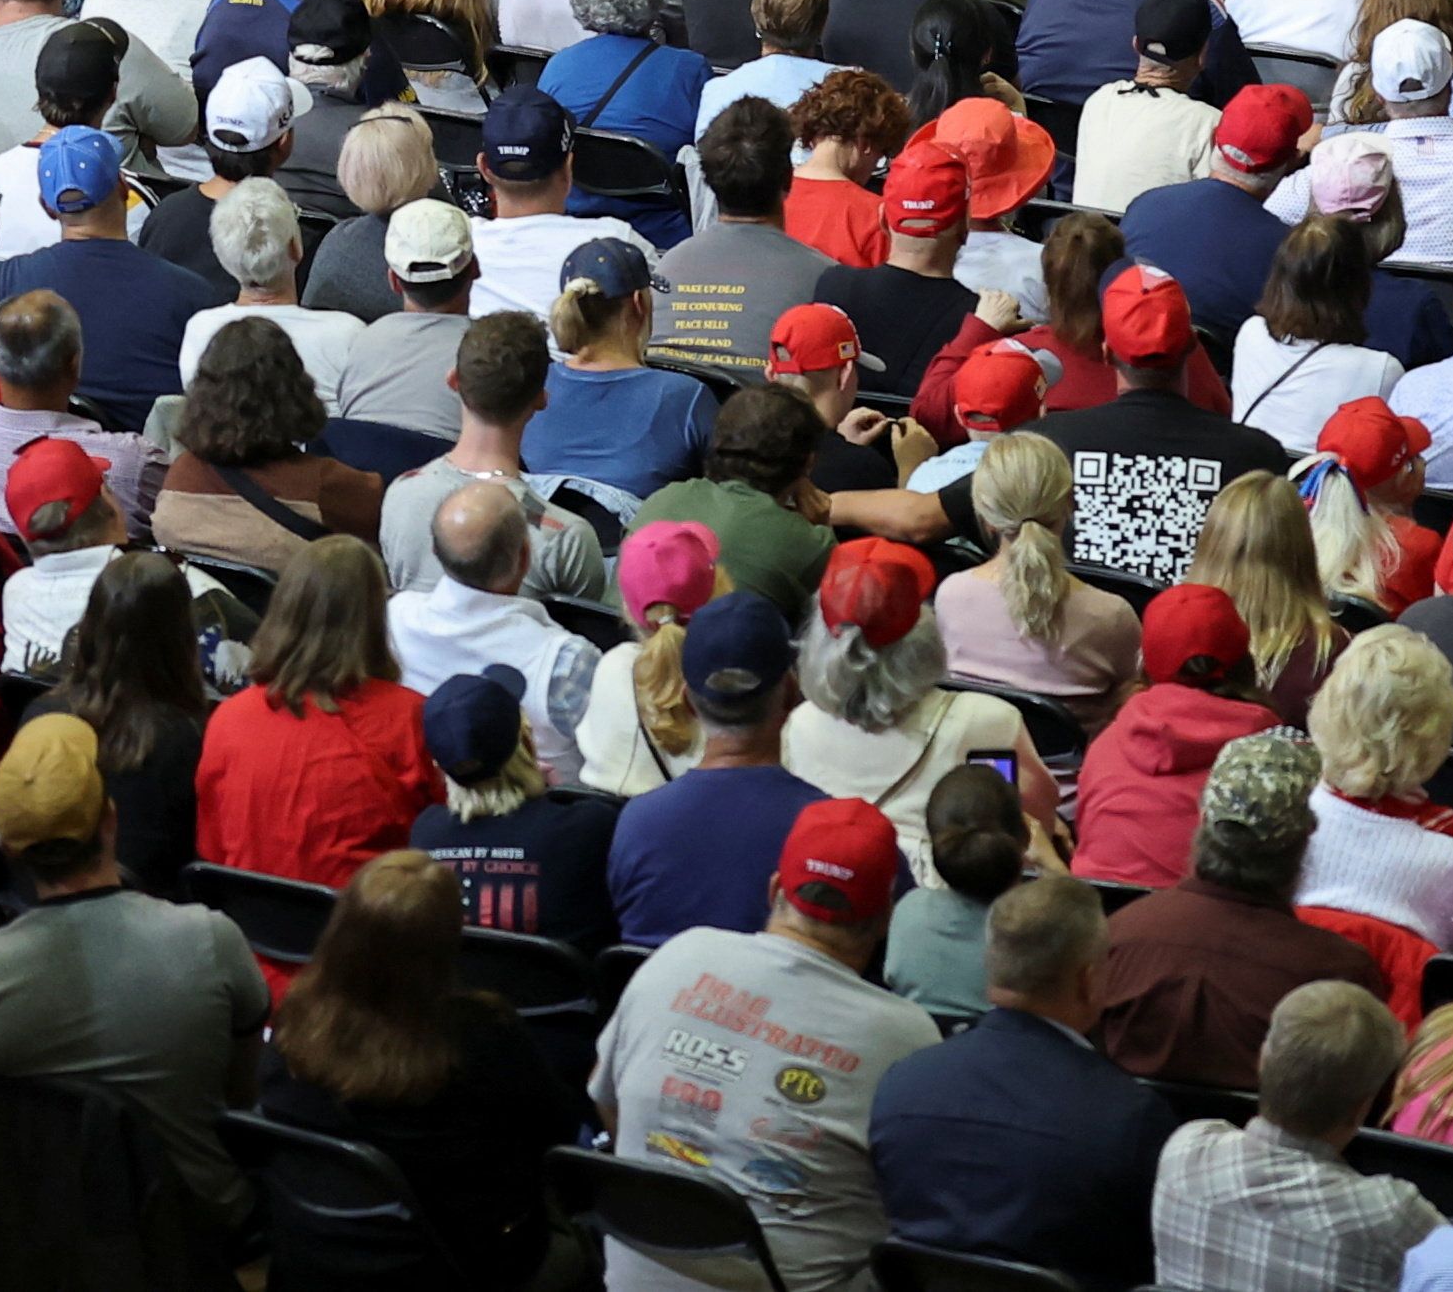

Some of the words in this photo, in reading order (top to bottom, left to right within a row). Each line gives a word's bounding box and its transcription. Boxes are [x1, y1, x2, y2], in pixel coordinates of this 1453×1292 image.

[497, 145, 530, 156] TRUMP
[903, 199, 935, 210] TRUMP
[677, 284, 702, 294] WAKE
[717, 285, 745, 294] DEAD
[671, 302, 687, 311] THE
[688, 302, 743, 312] CONJURING
[675, 320, 702, 329] PEACE
[703, 321, 729, 330] SELLS
[702, 353, 733, 365] BLACK
[805, 858, 855, 881] TRUMP
[669, 989, 862, 1075] ILLUSTRATED
[667, 1028, 748, 1069] ROSS
[781, 1067, 822, 1093] PTC
